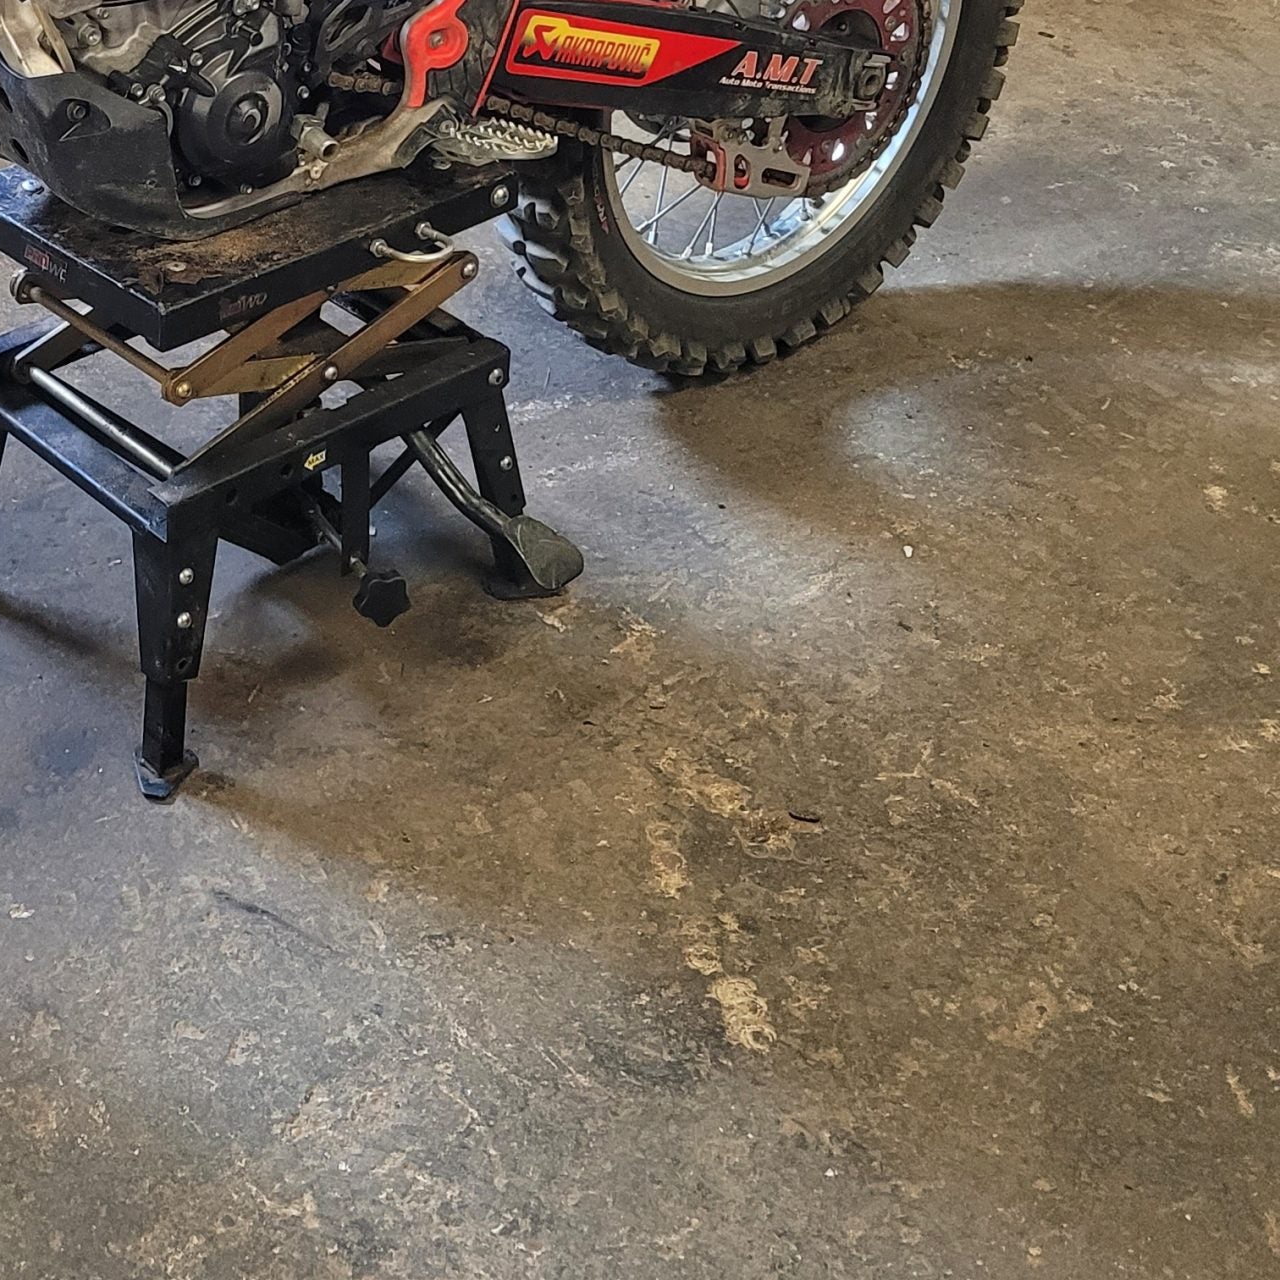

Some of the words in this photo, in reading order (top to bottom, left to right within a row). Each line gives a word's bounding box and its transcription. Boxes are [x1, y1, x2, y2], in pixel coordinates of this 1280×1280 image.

[731, 51, 824, 85] A.M.T
[719, 77, 740, 86] Auto
[741, 79, 763, 88] Moto
[765, 81, 817, 94] Transactions
